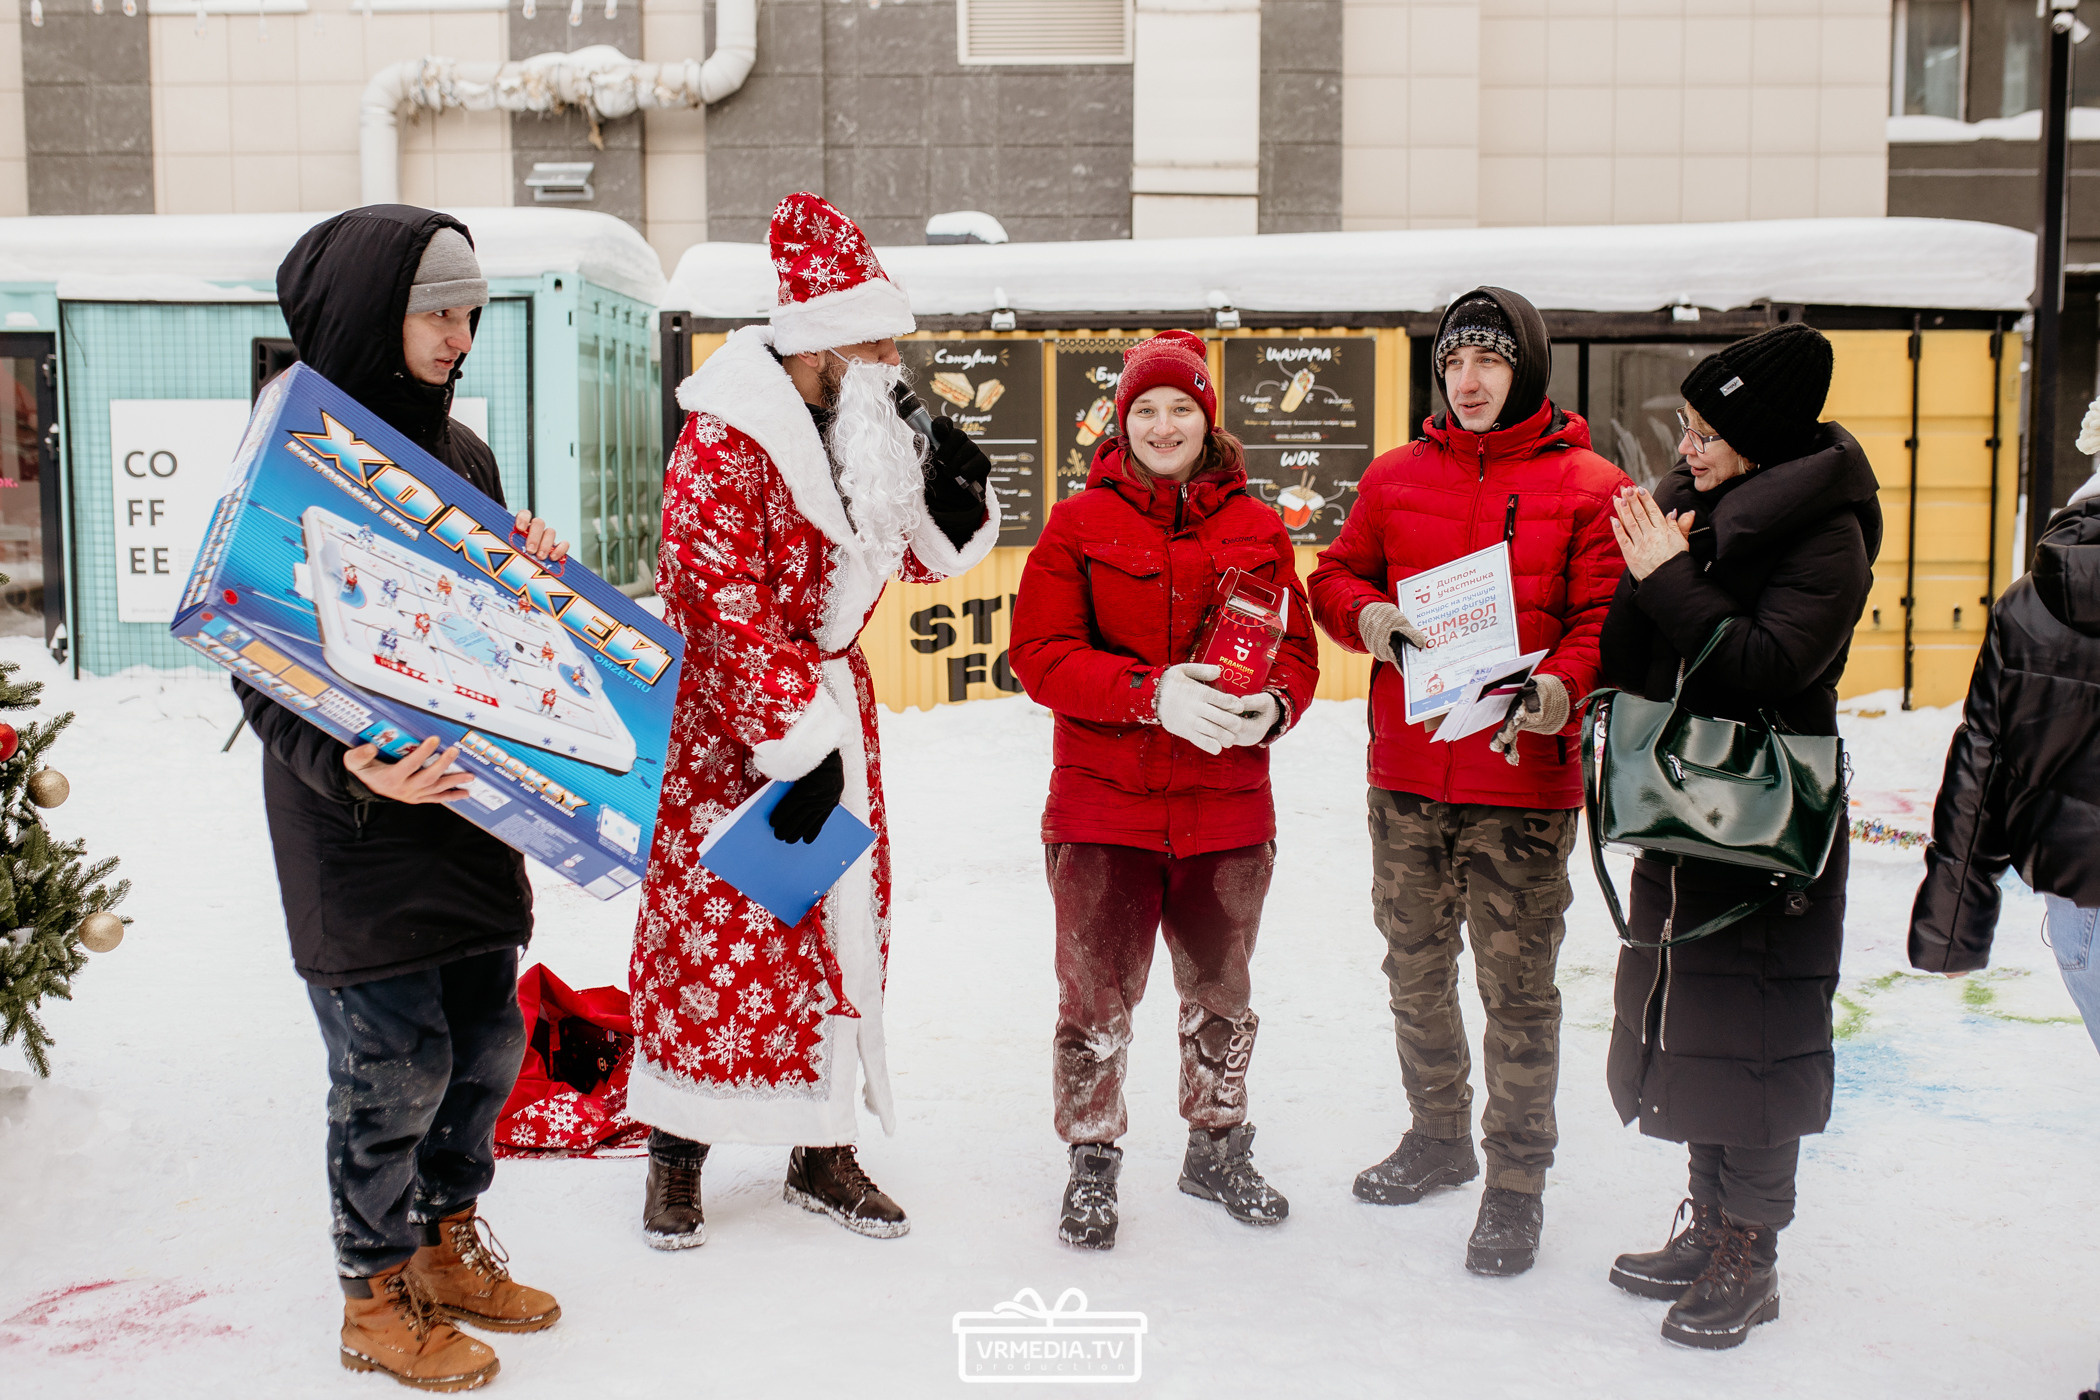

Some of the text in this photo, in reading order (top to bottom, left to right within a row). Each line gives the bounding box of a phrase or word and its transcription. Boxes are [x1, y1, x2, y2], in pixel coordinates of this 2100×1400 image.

[124, 450, 178, 478] CO
[1280, 450, 1320, 467] WOK
[284, 440, 420, 542] НАСТОЛЬНАЯ ИГРА
[127, 499, 165, 526] FF
[130, 547, 169, 574] EE
[288, 409, 674, 687] ХОККЕЙ
[1437, 569, 1476, 589] Диплом
[1438, 572, 1494, 598] участника
[1417, 602, 1449, 618] конкурс
[1462, 585, 1496, 602] лучшую
[1417, 594, 1496, 627] снежную фигуру
[910, 593, 1018, 654] ST
[1419, 631, 1458, 652] ОДА
[1461, 615, 1498, 637] 2022
[593, 654, 651, 693] OMZET.RU
[1219, 655, 1255, 675] РЕДАКЦИЯ
[460, 730, 590, 810] HOCKEY
[494, 766, 517, 782] GAME
[520, 782, 537, 794] FOR
[540, 794, 576, 818] CHILDREN
